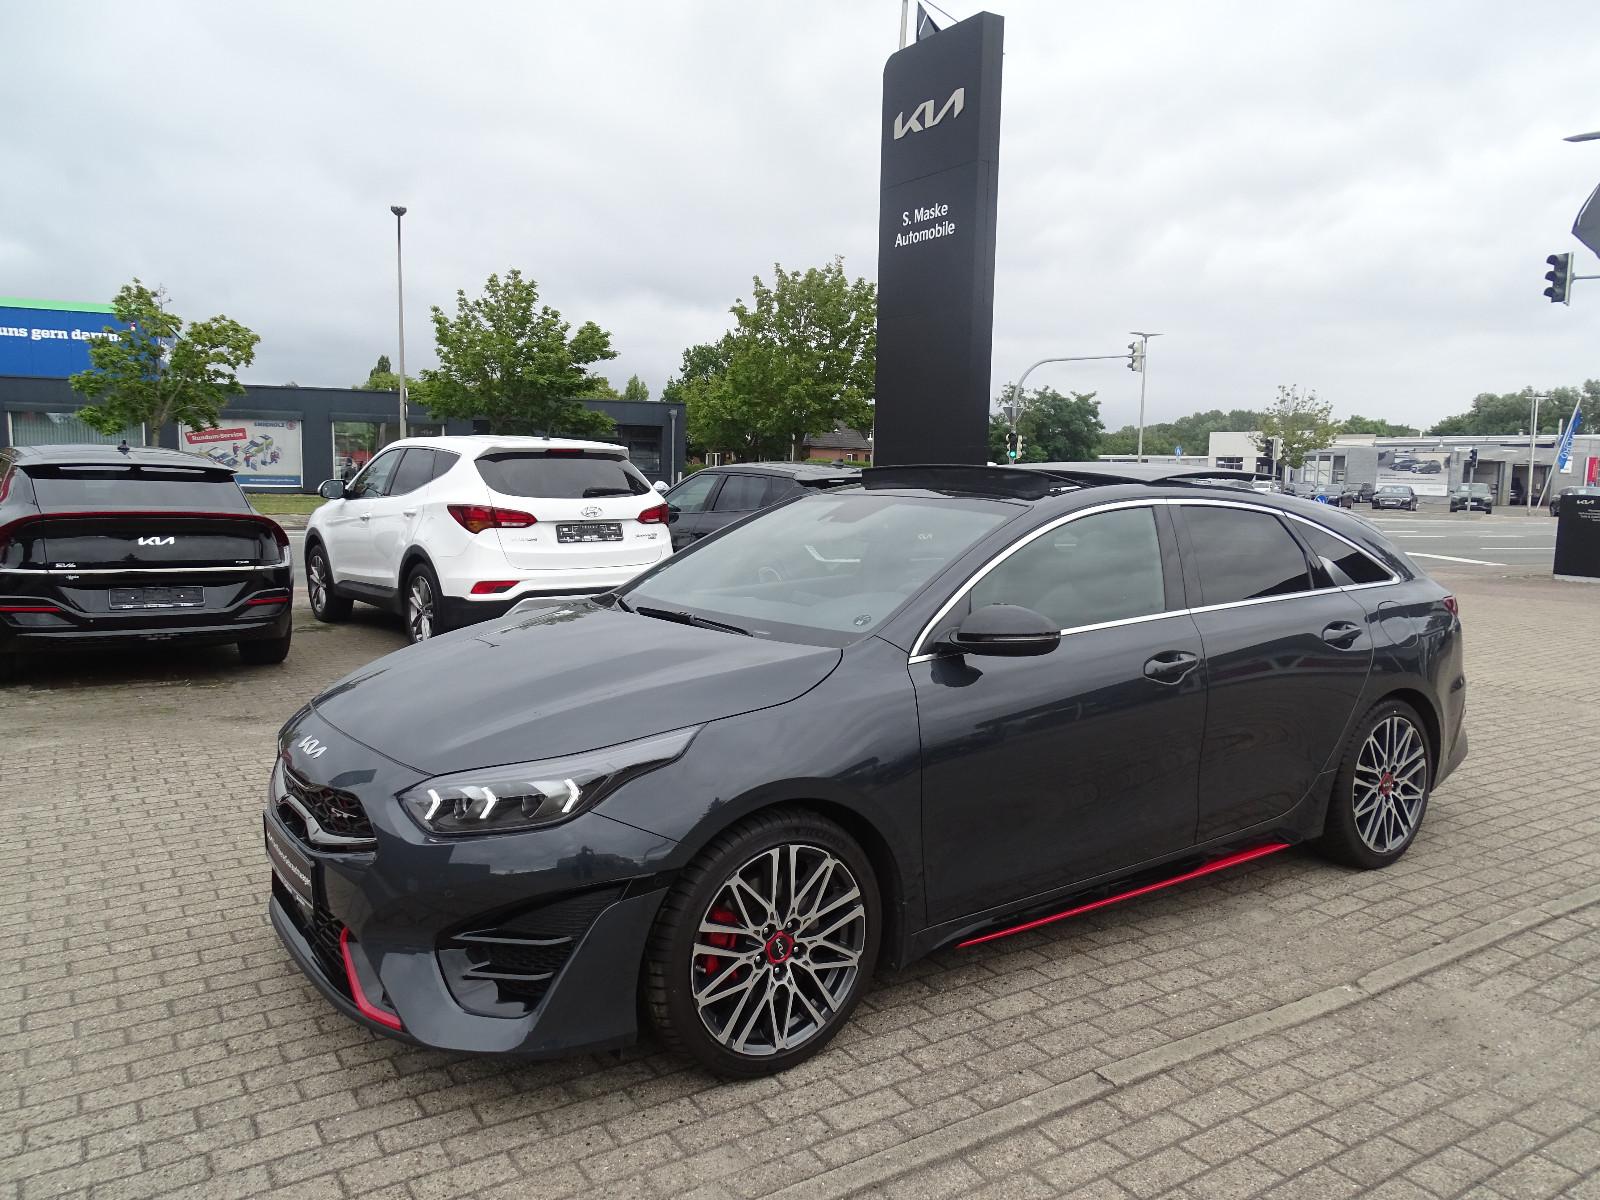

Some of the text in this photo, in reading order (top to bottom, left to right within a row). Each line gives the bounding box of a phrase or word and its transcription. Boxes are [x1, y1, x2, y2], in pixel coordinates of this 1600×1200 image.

[894, 88, 965, 140] KIA
[902, 203, 949, 226] S. Maske
[895, 220, 956, 248] Automobile
[0, 327, 28, 337] uns
[31, 328, 69, 341] gern
[191, 431, 244, 441] Rundum-Service
[138, 536, 175, 546] KIA
[298, 735, 328, 759] KIA
